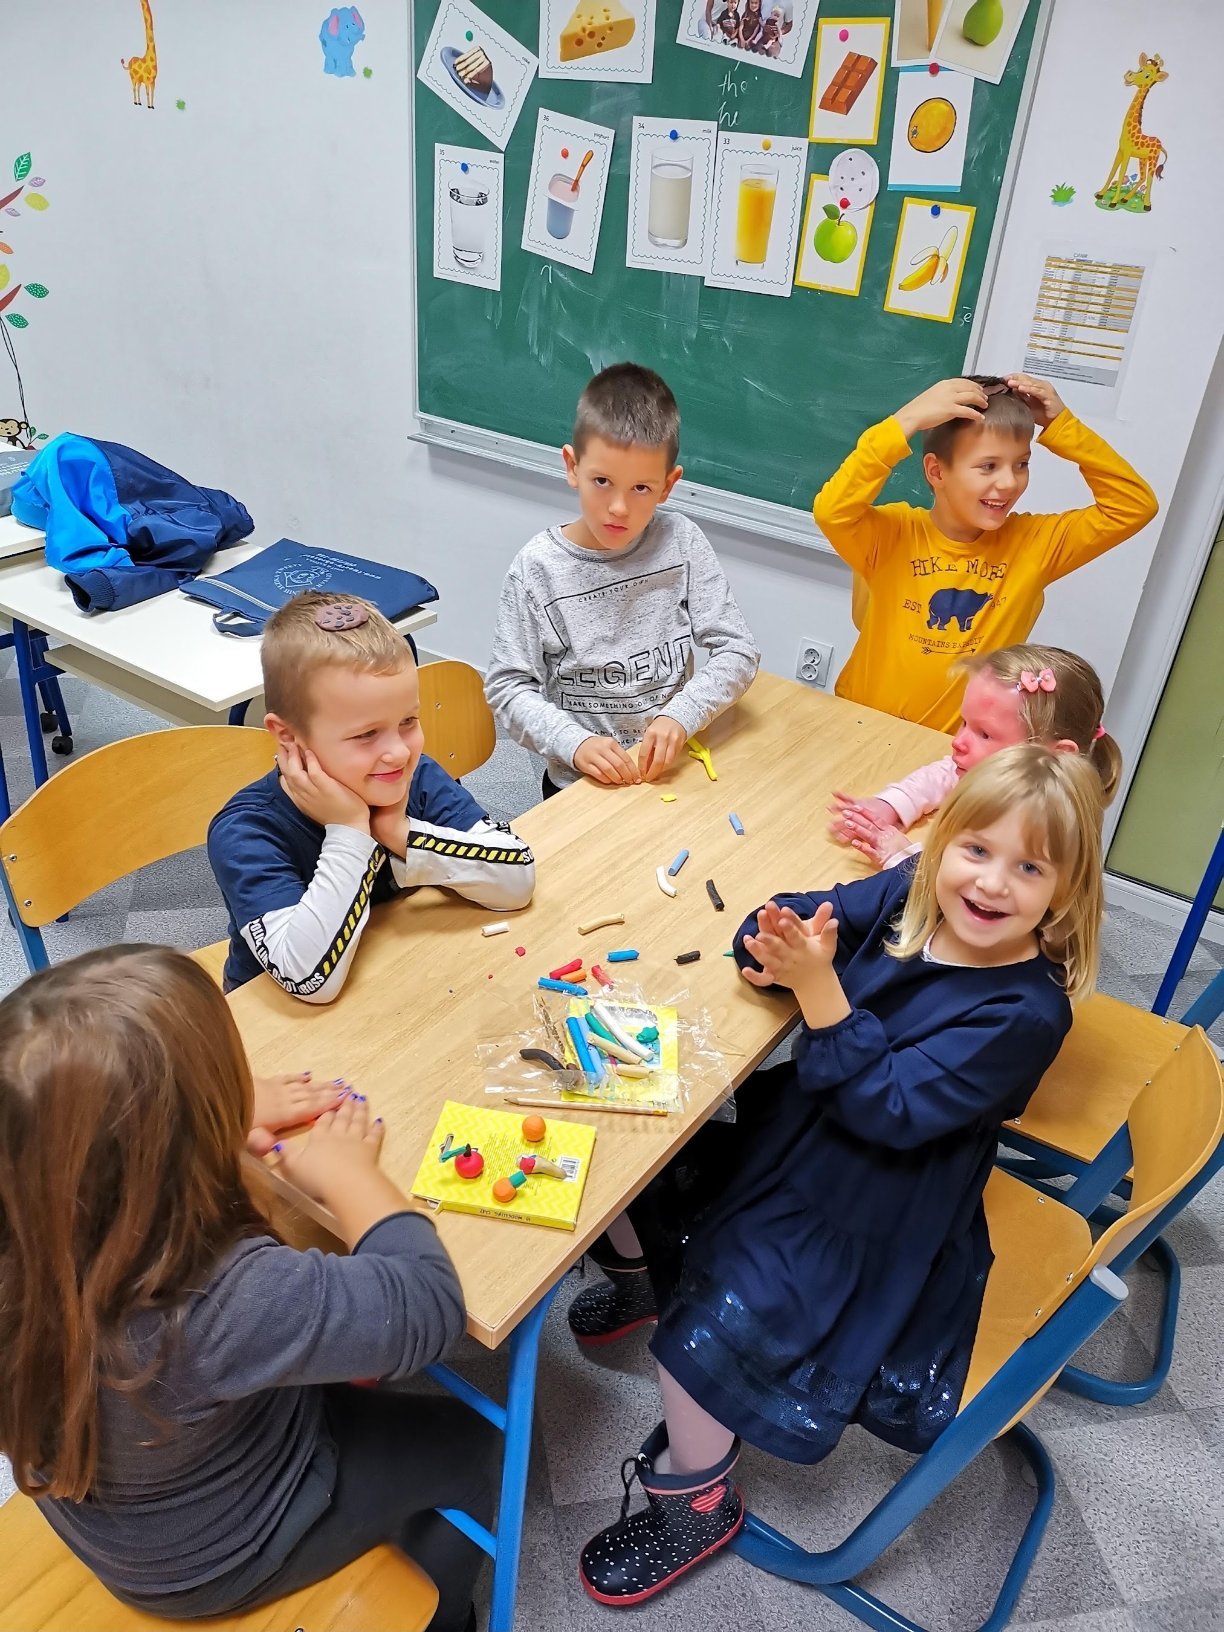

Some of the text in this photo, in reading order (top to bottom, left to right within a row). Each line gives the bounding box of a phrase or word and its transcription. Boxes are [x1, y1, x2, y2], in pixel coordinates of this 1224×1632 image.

[543, 114, 550, 122] 36
[638, 122, 645, 130] 34
[791, 145, 803, 153] juice
[910, 556, 957, 577] HIKE
[609, 584, 629, 594] YOUR
[632, 579, 649, 587] OWN
[908, 633, 950, 649] MOUNTAINS
